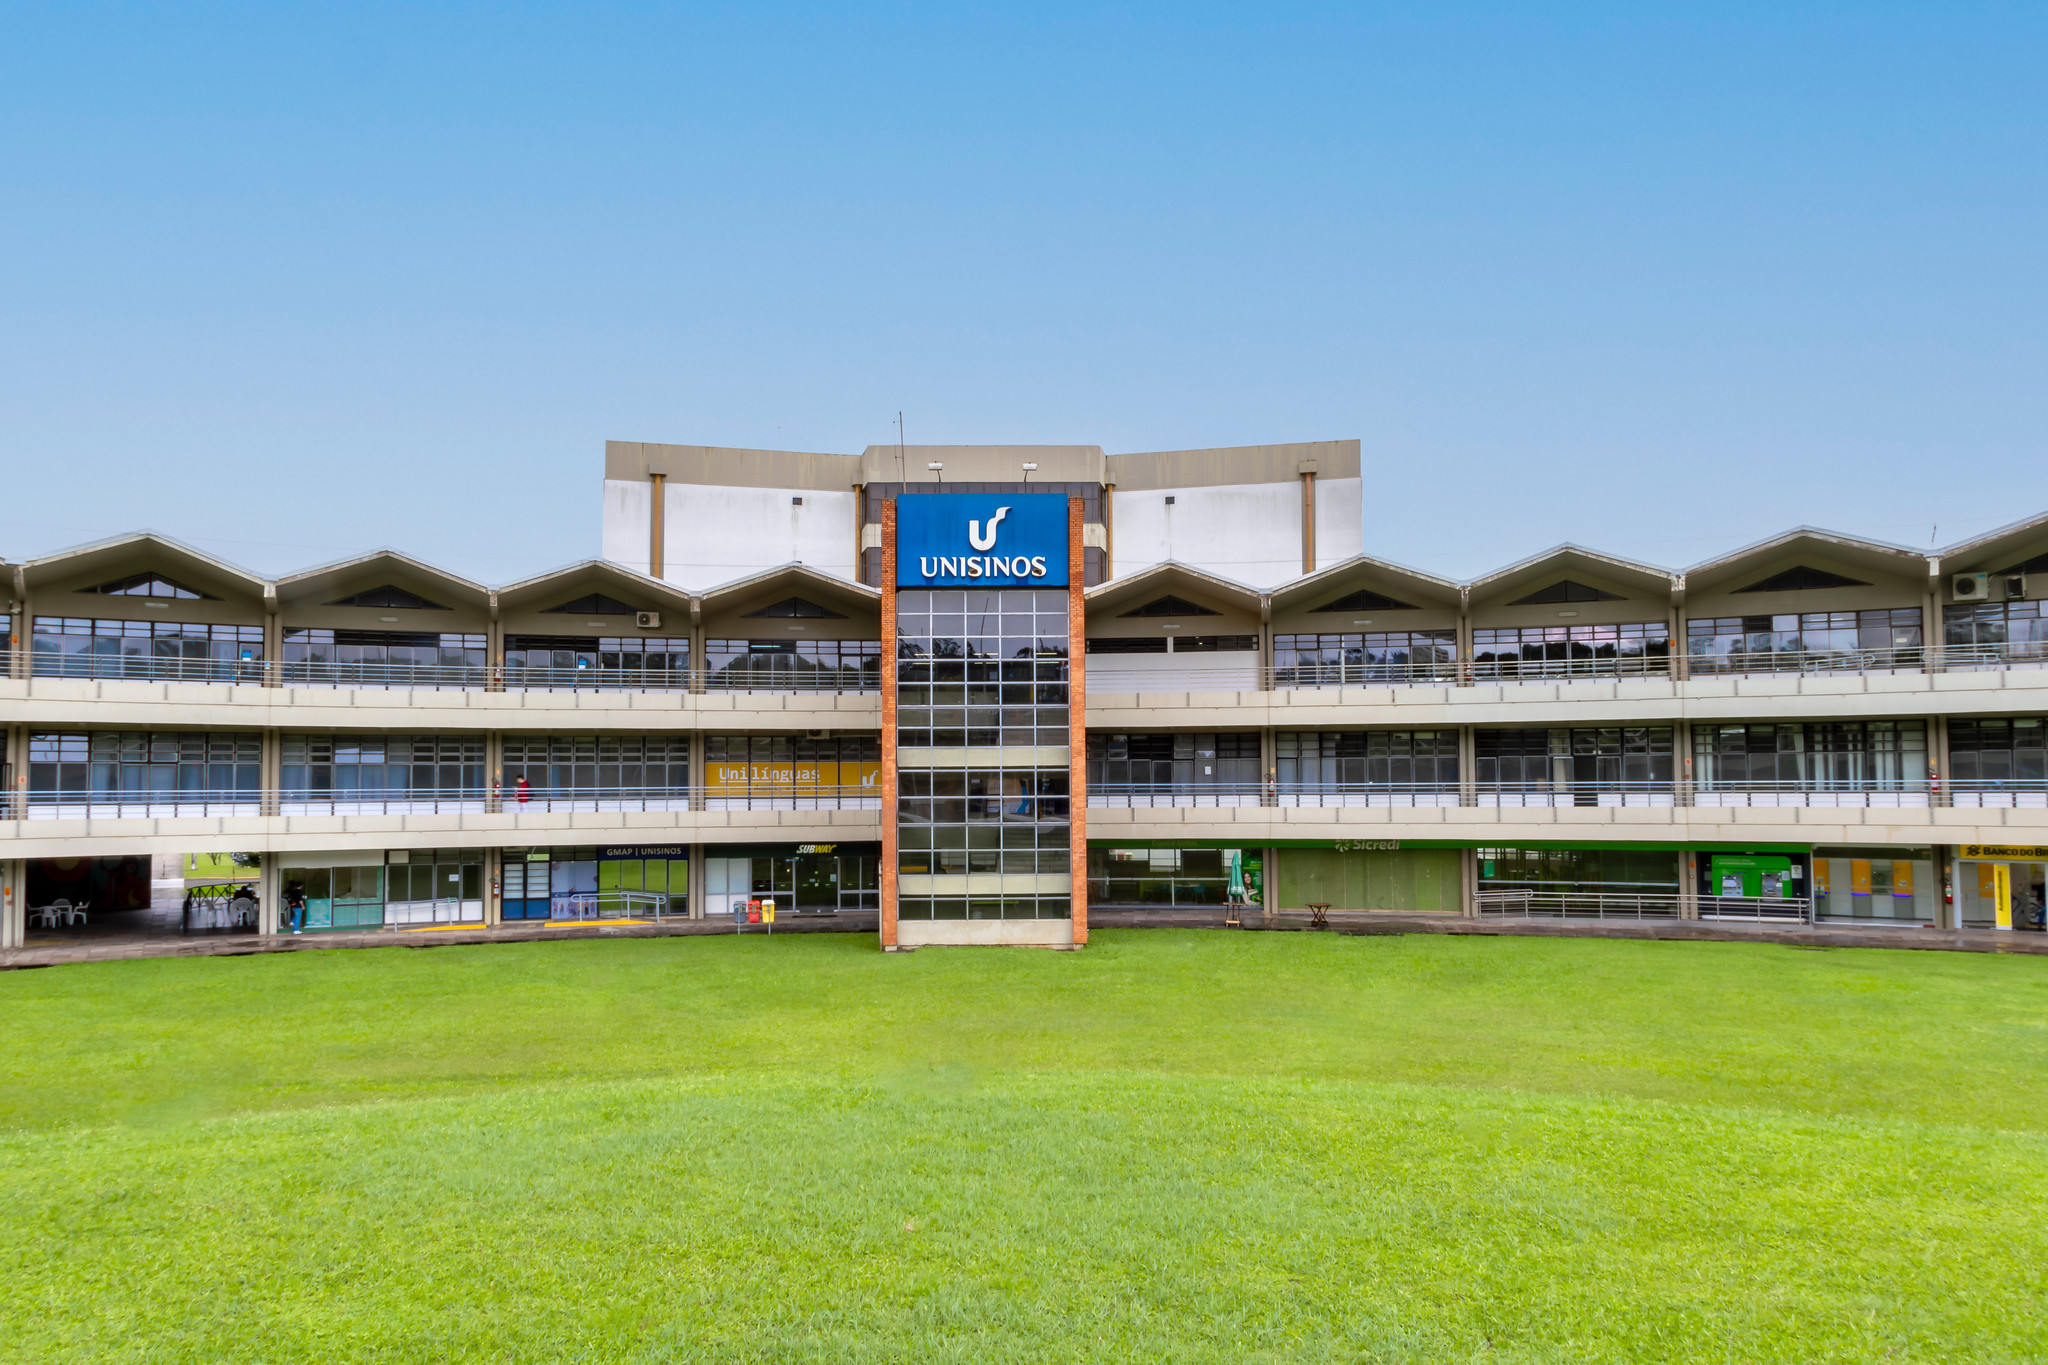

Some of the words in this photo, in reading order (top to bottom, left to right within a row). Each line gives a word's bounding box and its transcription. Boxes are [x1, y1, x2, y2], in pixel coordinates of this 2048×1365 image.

[920, 557, 1047, 577] UNISINOS
[796, 845, 837, 853] SUBWAY
[1353, 839, 1400, 850] Sicredi
[606, 848, 633, 856] GMAP
[641, 847, 682, 855] UNISINOS
[1983, 847, 2018, 855] BANCO
